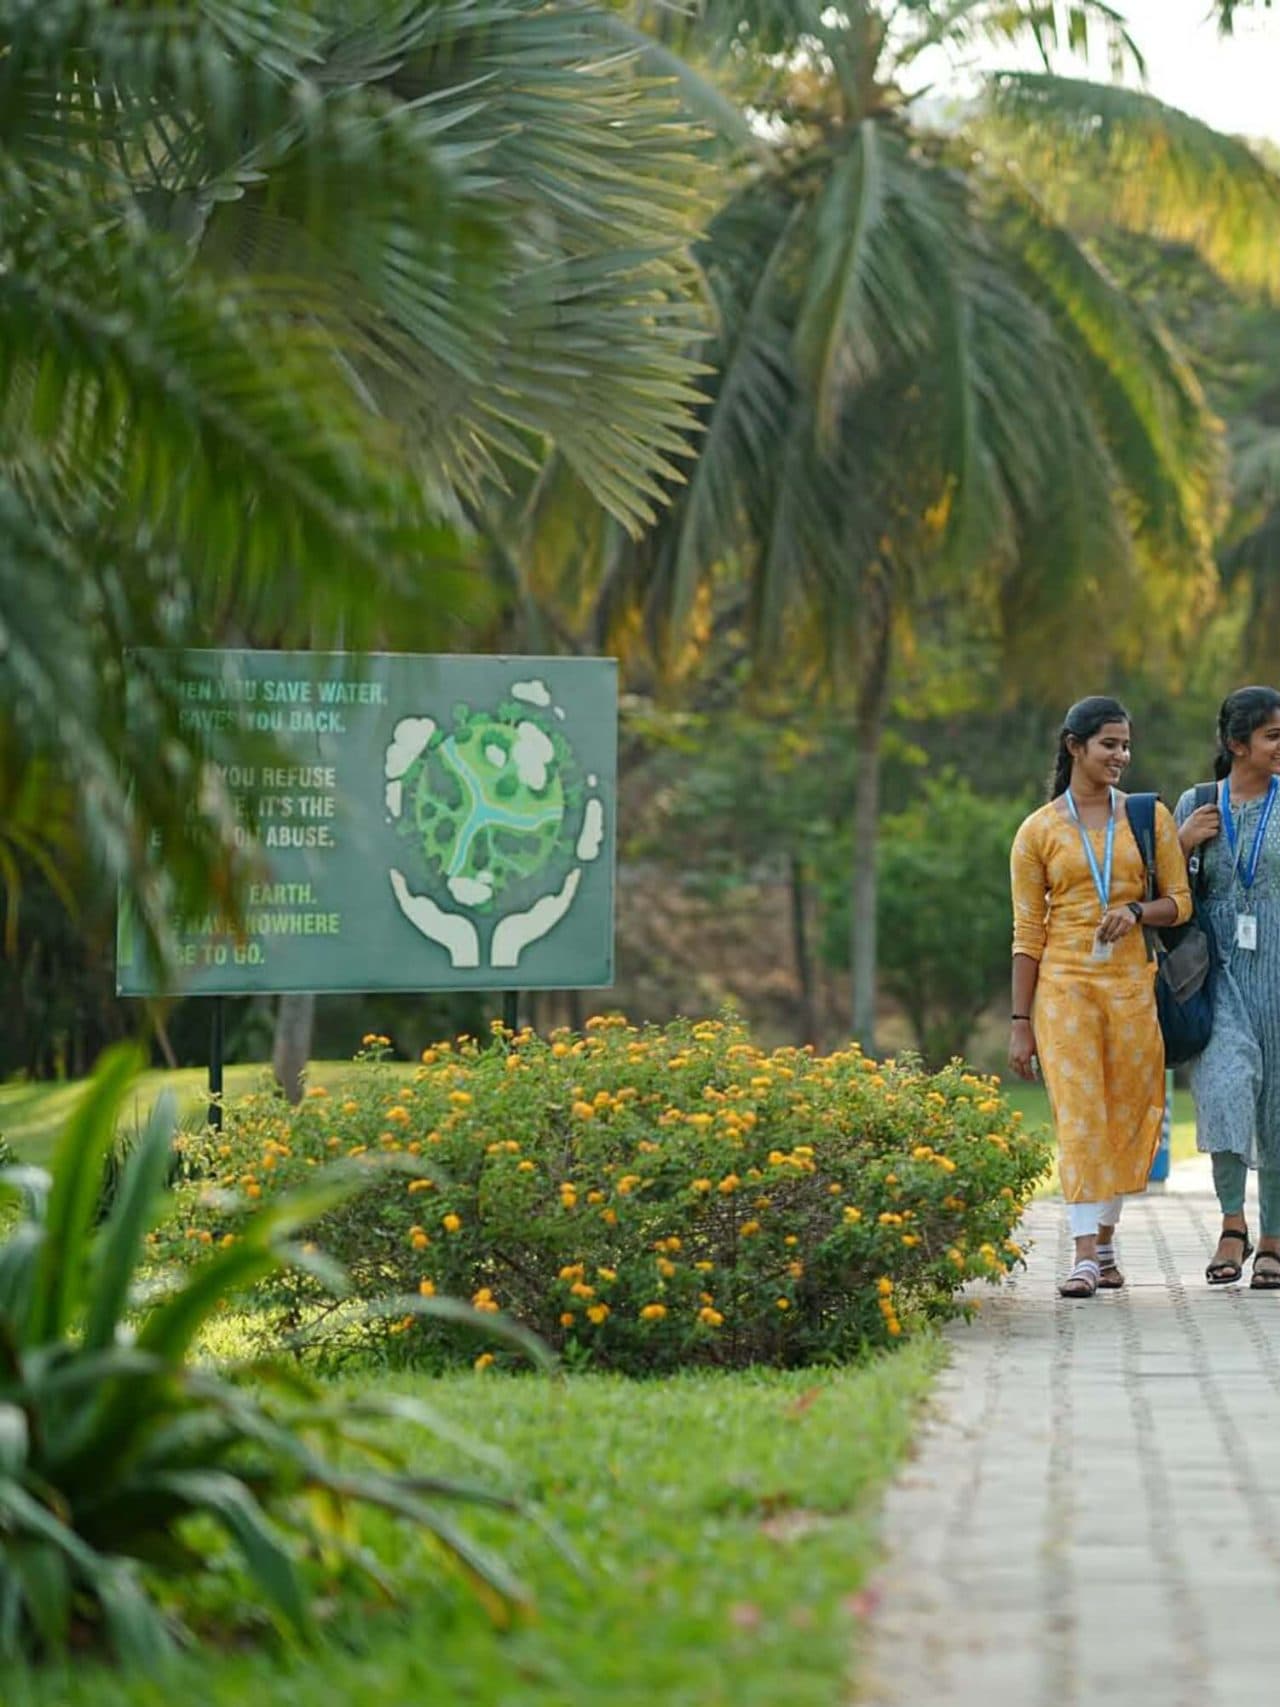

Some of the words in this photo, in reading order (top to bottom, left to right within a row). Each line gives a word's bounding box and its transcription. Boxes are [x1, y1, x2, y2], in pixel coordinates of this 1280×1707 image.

[263, 680, 311, 702] SAVE
[290, 711, 347, 733] BACK.
[262, 767, 336, 787] REFUSE
[259, 796, 293, 817] IT'S
[300, 796, 335, 817] THE
[266, 825, 335, 847] ABUSE.
[251, 883, 318, 905] EARTH.
[246, 913, 341, 934] NOWHERE
[204, 944, 227, 965] TO
[234, 943, 265, 965] GO.
